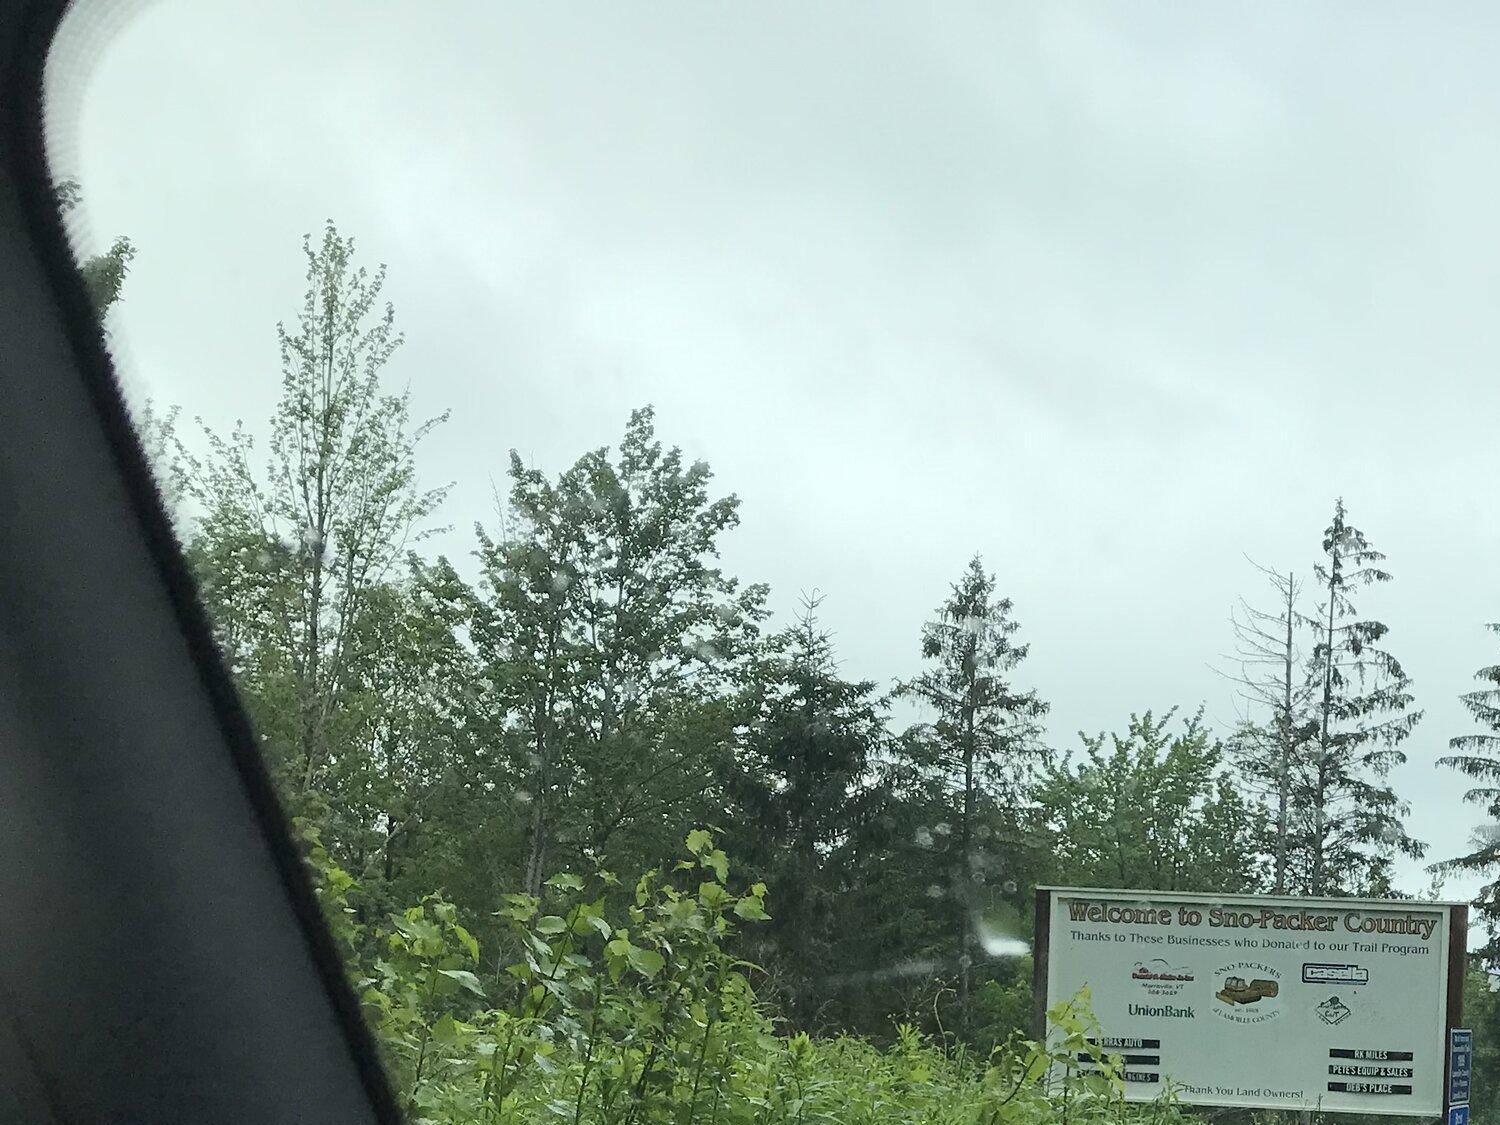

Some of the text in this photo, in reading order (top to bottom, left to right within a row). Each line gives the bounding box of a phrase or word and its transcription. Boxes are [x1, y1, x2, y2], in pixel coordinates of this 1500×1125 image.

[1068, 902, 1437, 940] Welcome to Sno-Packer Country
[1070, 930, 1430, 956] Thanks to These Businesses who Donated to our Trail Program
[1128, 1003, 1195, 1019] UnionBank
[1123, 1038, 1143, 1048] AUTO
[1354, 1049, 1388, 1060] RK MILES
[1332, 1065, 1409, 1077] PETE'S EQUIP & SALES
[1215, 1086, 1234, 1096] You
[1236, 1087, 1261, 1097] Land
[1346, 1083, 1393, 1094] DEB'S PLACE
